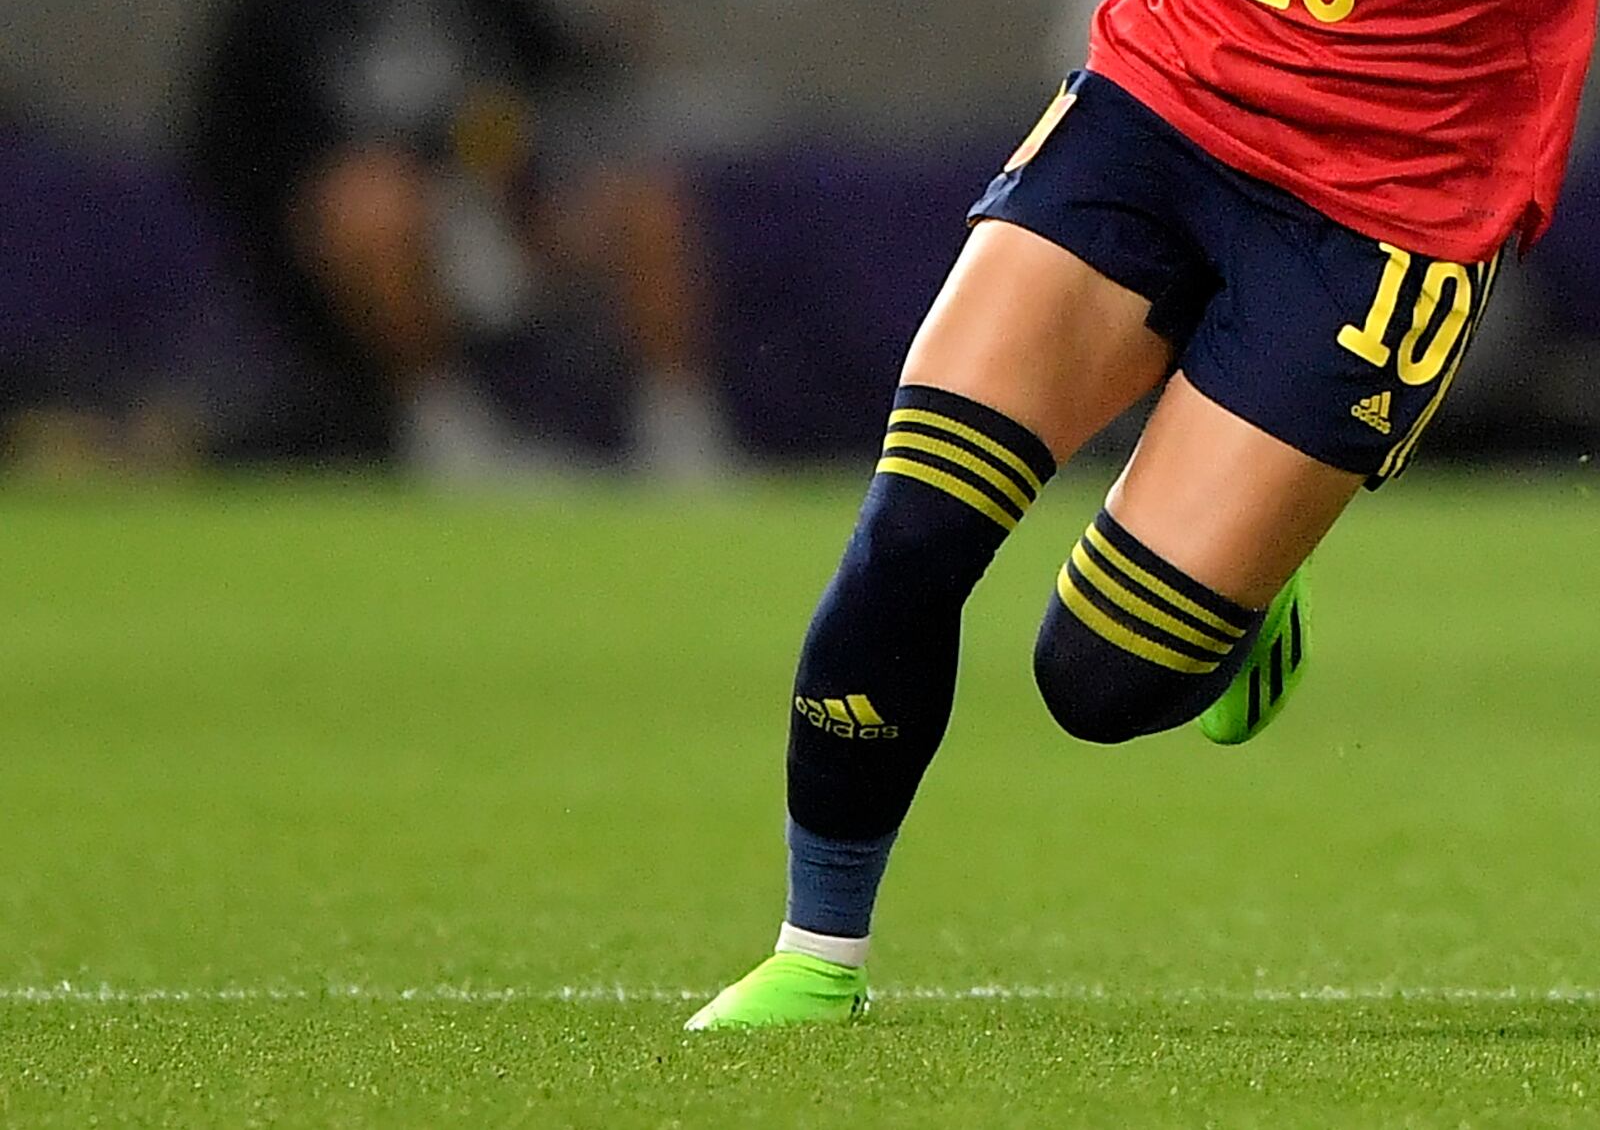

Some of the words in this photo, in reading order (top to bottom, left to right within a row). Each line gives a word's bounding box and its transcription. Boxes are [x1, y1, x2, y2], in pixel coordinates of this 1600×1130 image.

[1336, 241, 1472, 386] 10
[1351, 404, 1391, 434] adidas
[795, 696, 899, 739] adidas
